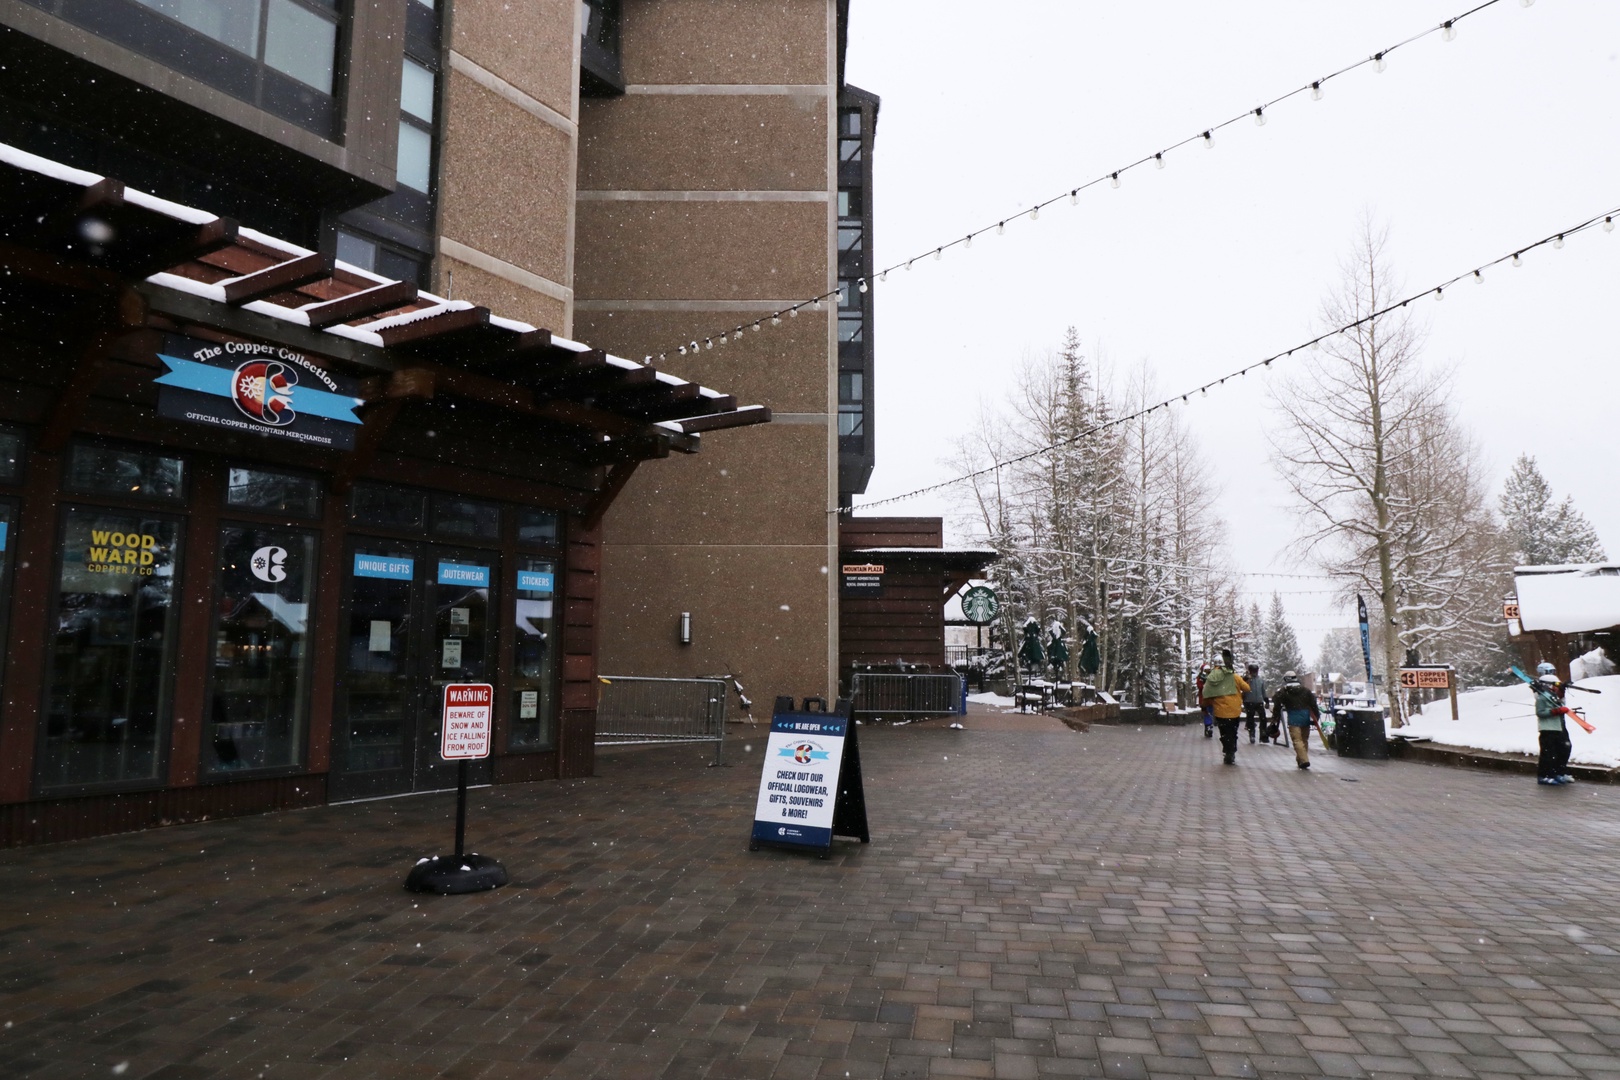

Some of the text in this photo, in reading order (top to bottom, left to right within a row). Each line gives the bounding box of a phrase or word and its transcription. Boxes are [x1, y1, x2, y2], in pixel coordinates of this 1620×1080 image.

[194, 341, 338, 392] The Copper Collection
[186, 412, 332, 444] OFFICIAL COPPER MOUNTAIN MERCHANDISE
[91, 530, 155, 549] WOOD
[90, 547, 154, 565] WARD
[88, 564, 127, 574] COPPER
[140, 567, 152, 576] CO
[358, 560, 410, 574] UNIQUE GIFTS
[444, 569, 484, 581] OUTERWEAR
[521, 576, 550, 587] STICKERS
[450, 690, 488, 702] WARNING
[449, 711, 475, 719] BEWARE
[450, 722, 469, 730] SNOW
[795, 722, 821, 731] WE ARE OPEN
[460, 732, 486, 740] FALLING
[447, 743, 465, 751] FROM
[776, 770, 823, 782] CHECK OUT OUR
[767, 781, 829, 797] OFFICIAL LOGOWEAR,
[769, 794, 824, 808] GIFTS, SOUVENIRS
[782, 807, 808, 819] & MORE!
